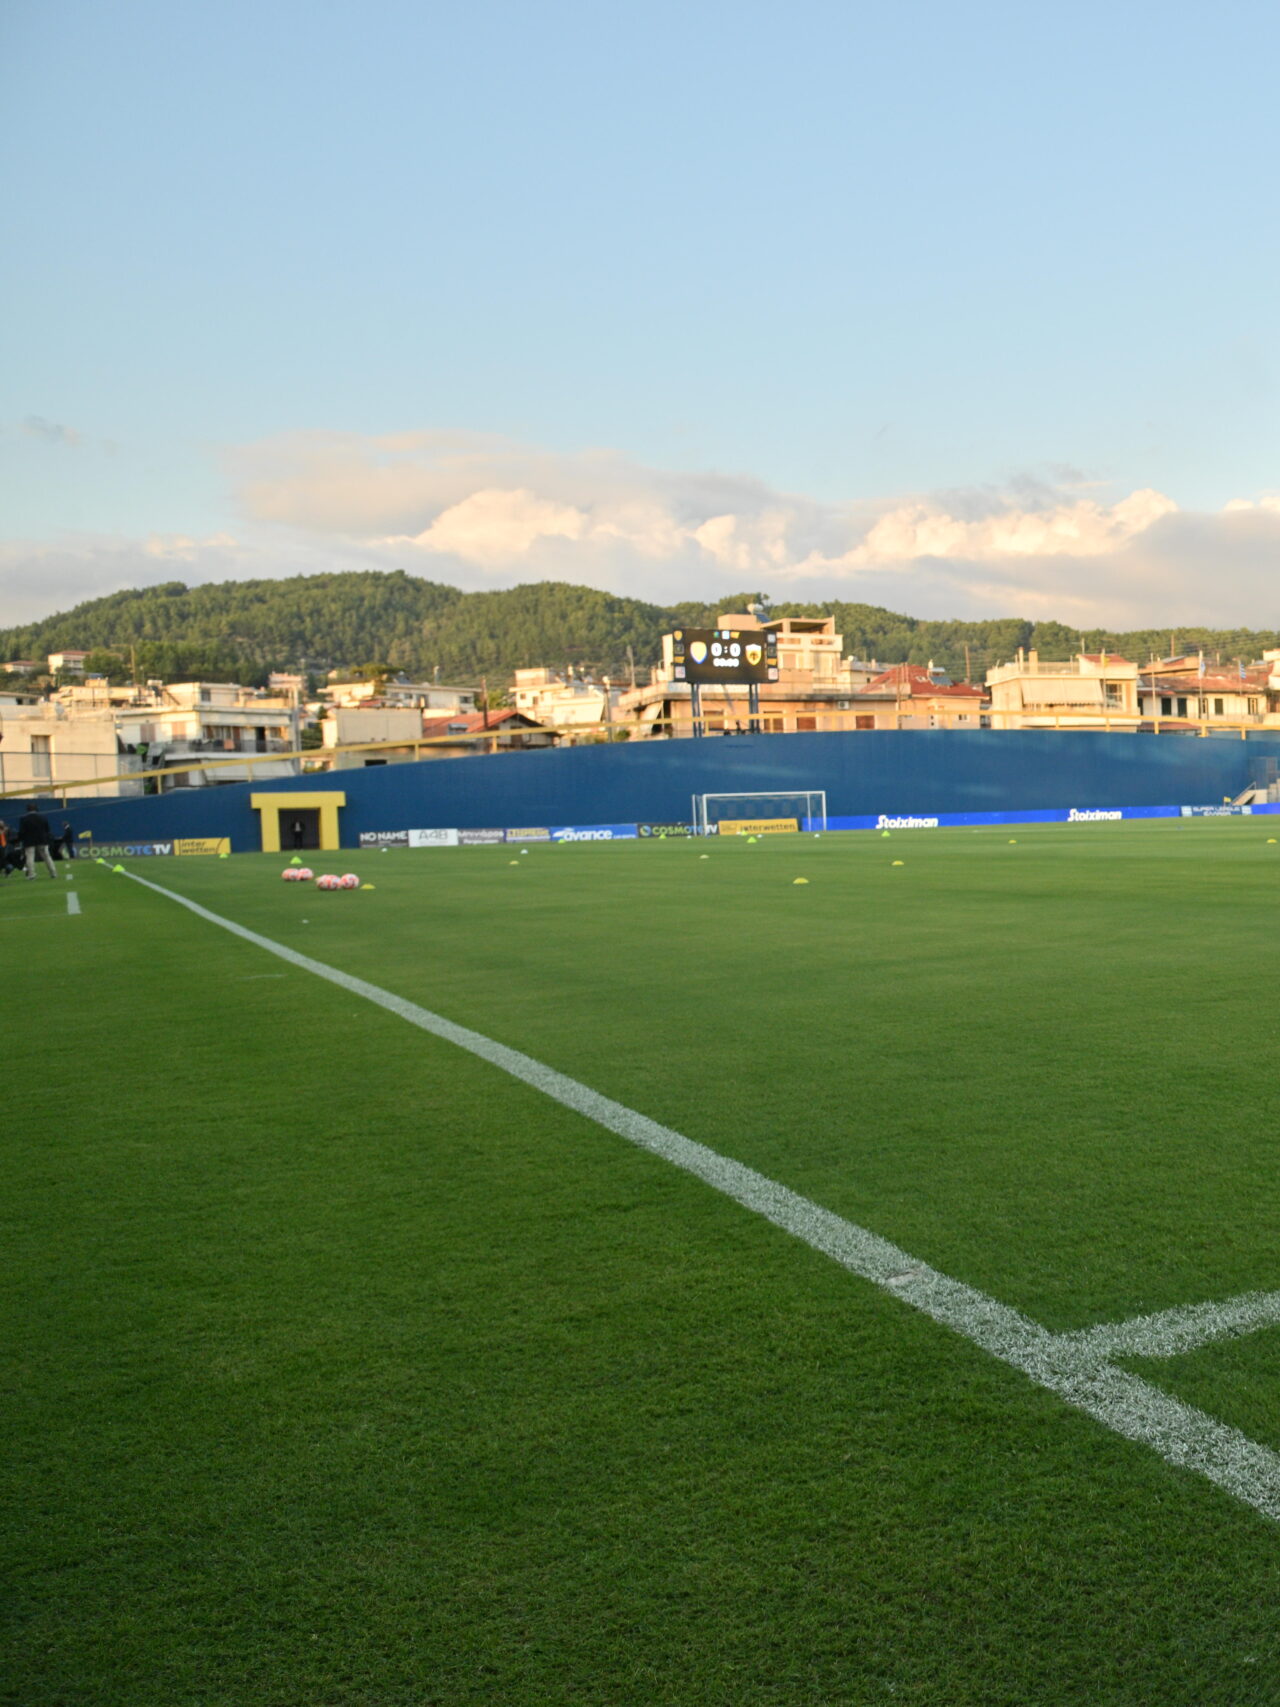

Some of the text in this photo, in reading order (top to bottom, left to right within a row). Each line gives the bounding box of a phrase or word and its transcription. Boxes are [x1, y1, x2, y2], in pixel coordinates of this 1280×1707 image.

[876, 814, 938, 829] Stoiximan
[1067, 808, 1122, 822] Stoiximan
[360, 830, 408, 842] NO NAME
[563, 829, 612, 841] avance
[79, 843, 171, 858] COSMOTE TV
